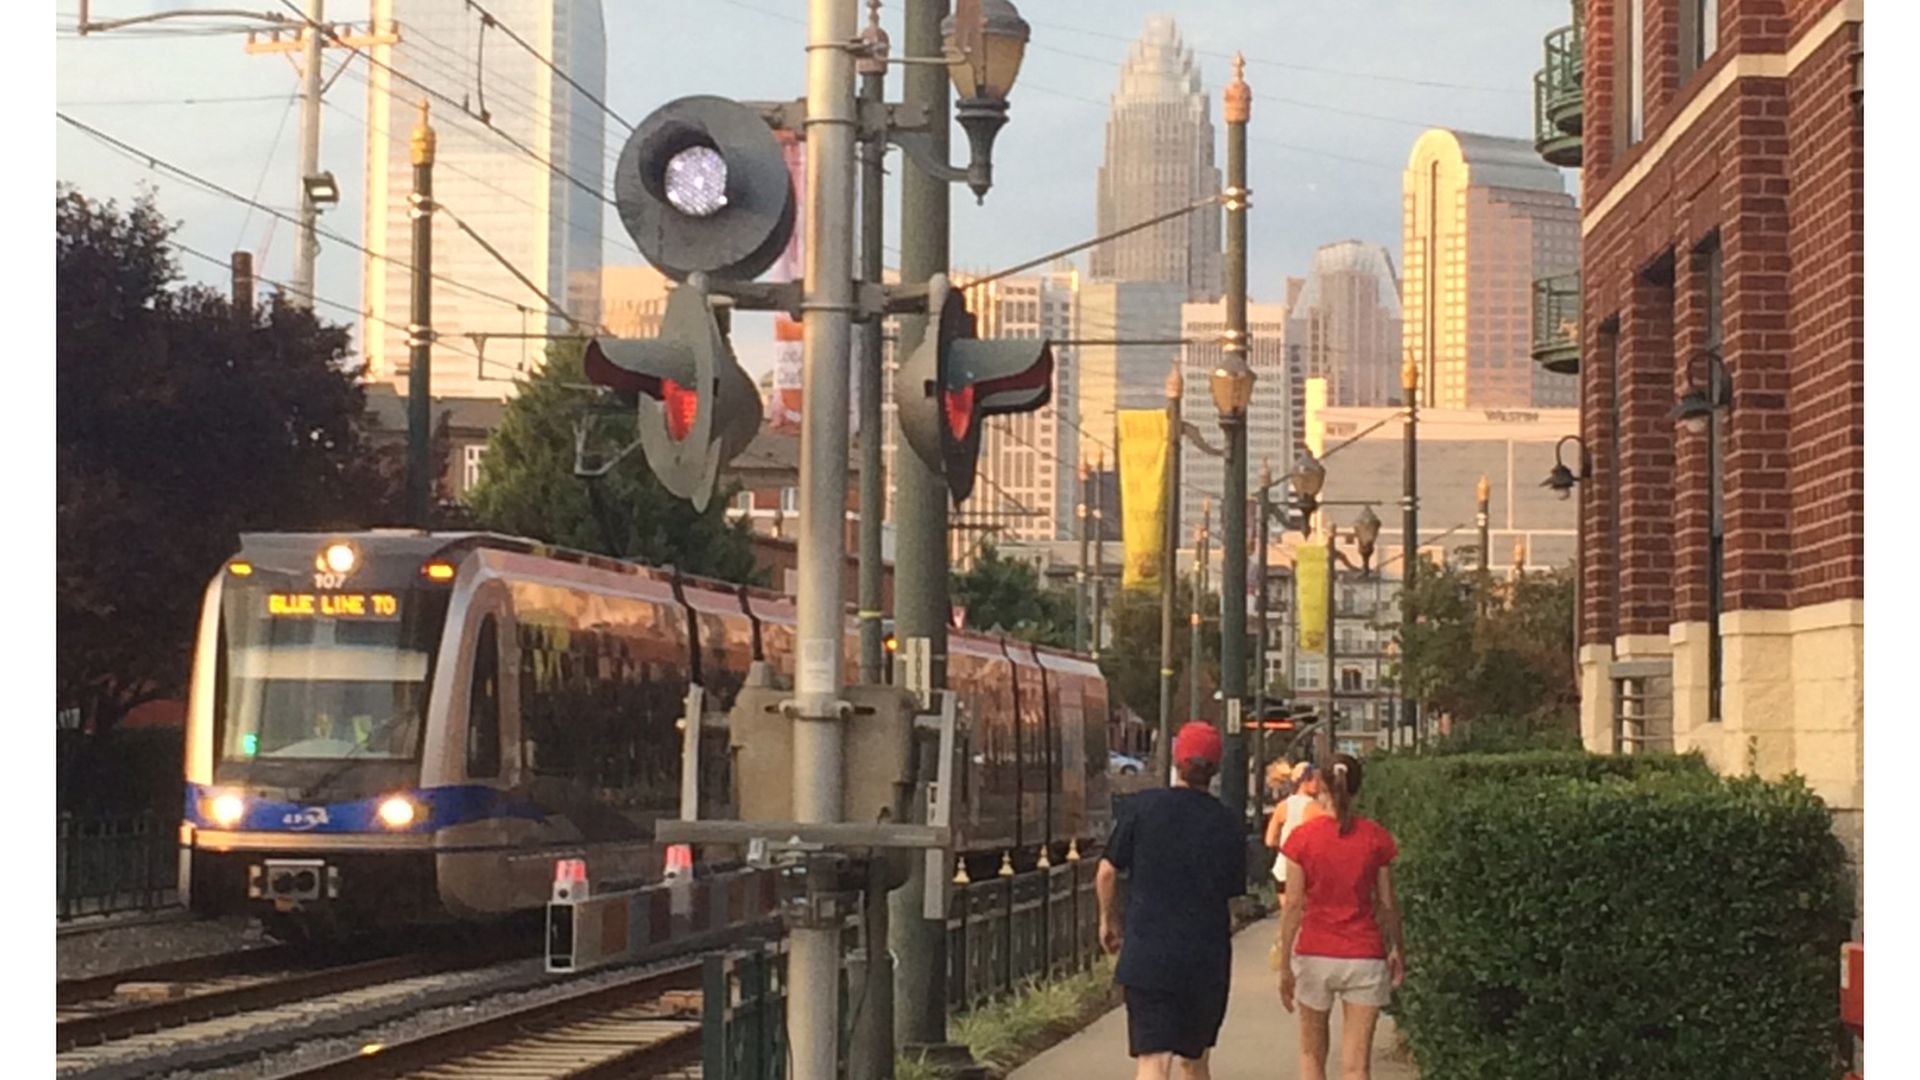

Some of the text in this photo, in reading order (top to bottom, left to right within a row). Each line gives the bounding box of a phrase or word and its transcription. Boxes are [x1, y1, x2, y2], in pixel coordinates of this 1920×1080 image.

[314, 573, 347, 589] 107
[269, 594, 397, 615] BLUE LINE TO
